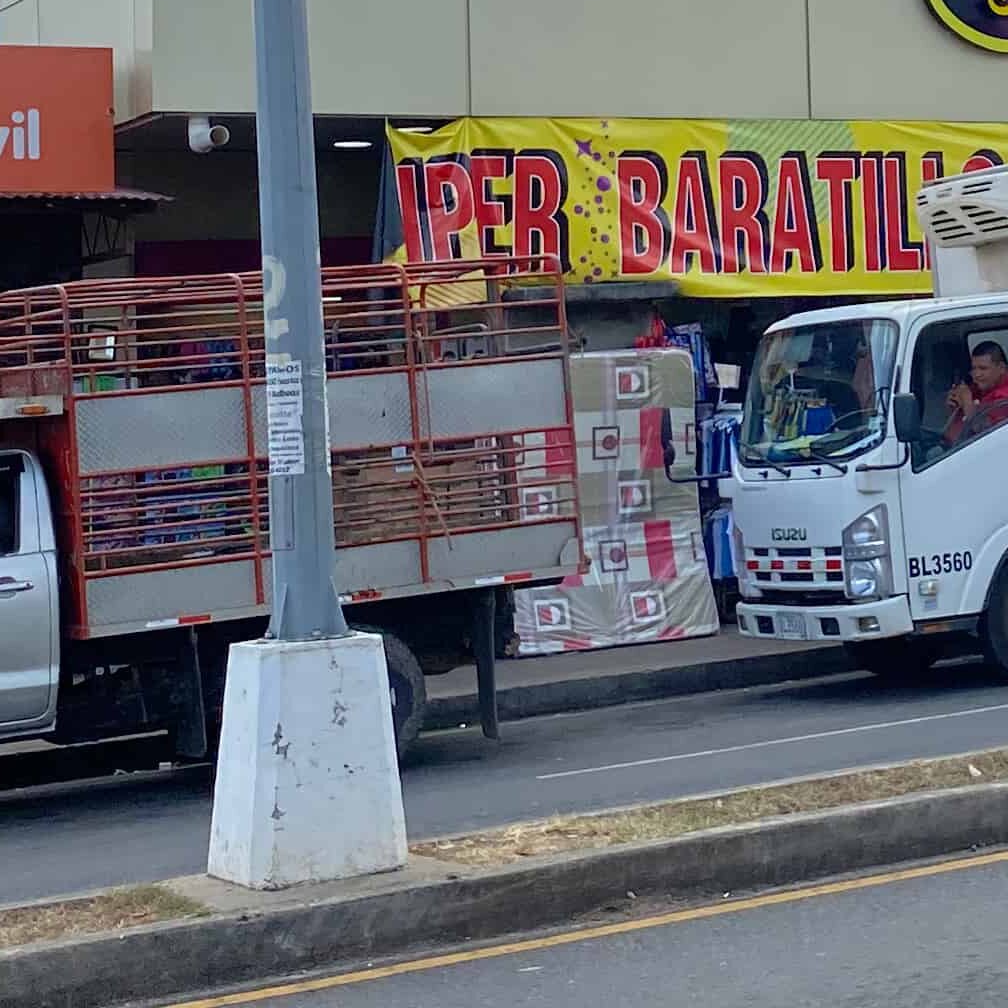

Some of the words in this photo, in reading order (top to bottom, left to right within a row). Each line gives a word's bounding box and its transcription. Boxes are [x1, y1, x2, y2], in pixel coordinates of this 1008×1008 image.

[616, 151, 1003, 275] BARATIL
[771, 528, 807, 541] ISUZU
[908, 551, 973, 578] BL3560
